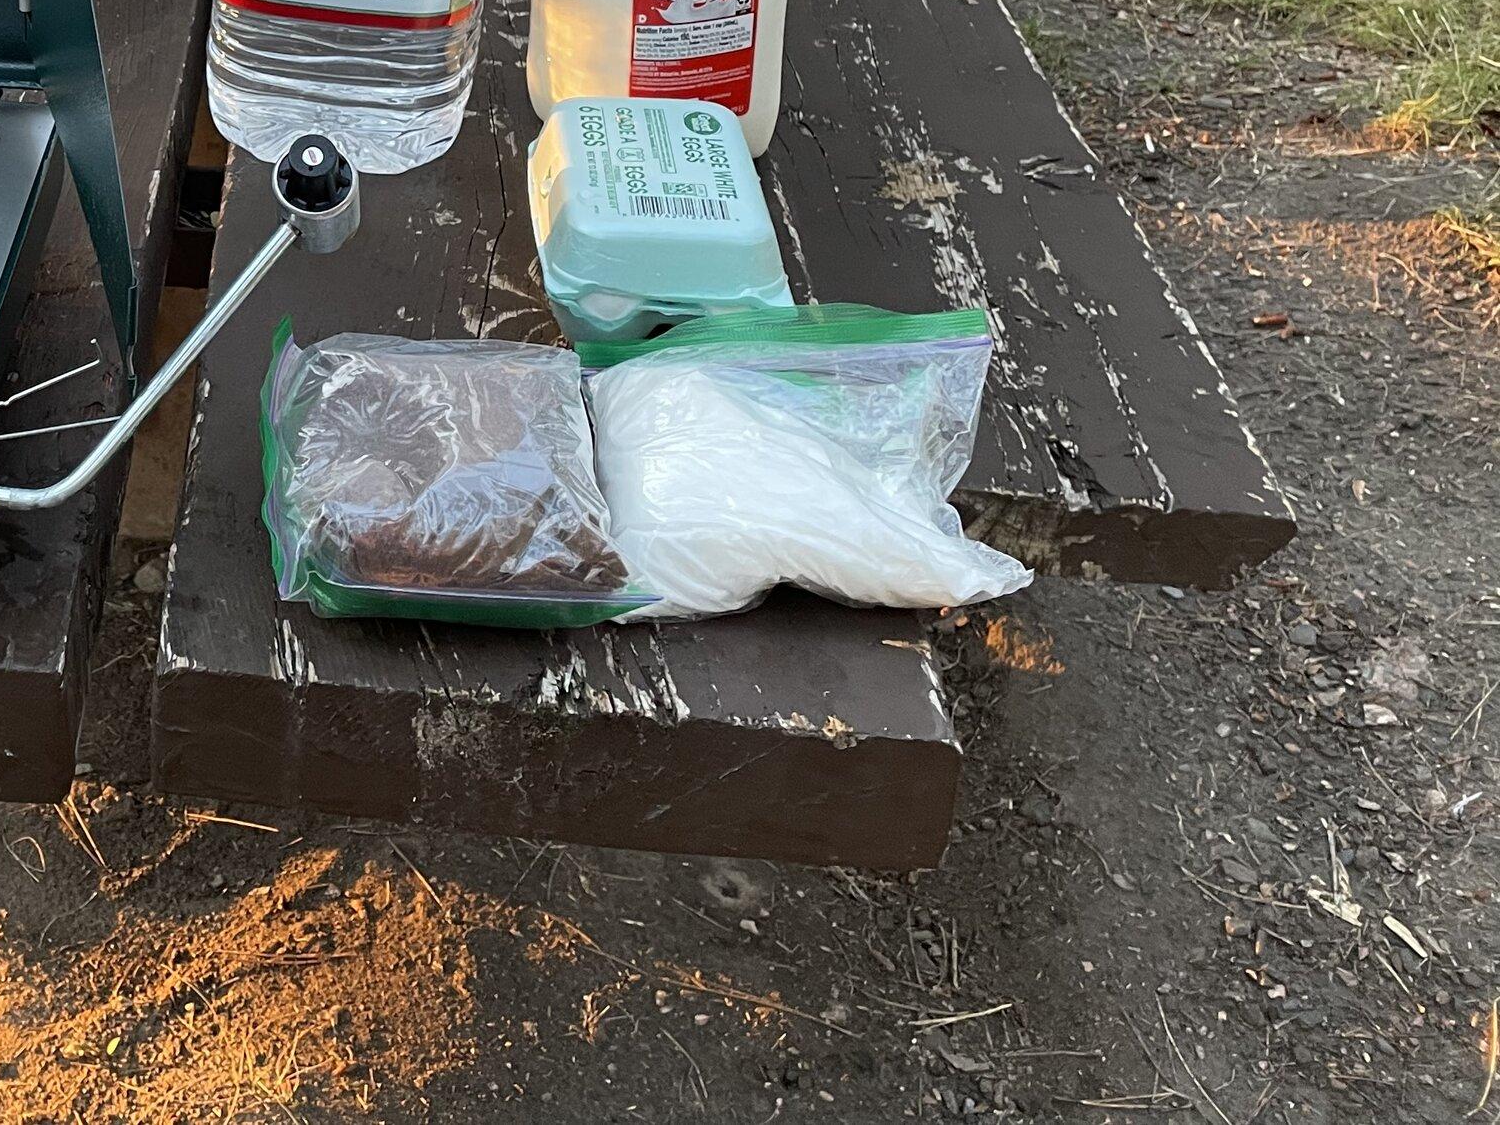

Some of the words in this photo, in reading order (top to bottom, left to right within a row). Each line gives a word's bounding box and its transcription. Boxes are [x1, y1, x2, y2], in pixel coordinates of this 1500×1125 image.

[581, 116, 605, 146] EGGS
[705, 138, 730, 168] LARGE
[625, 166, 648, 194] EGGS
[714, 171, 738, 199] WHITE
